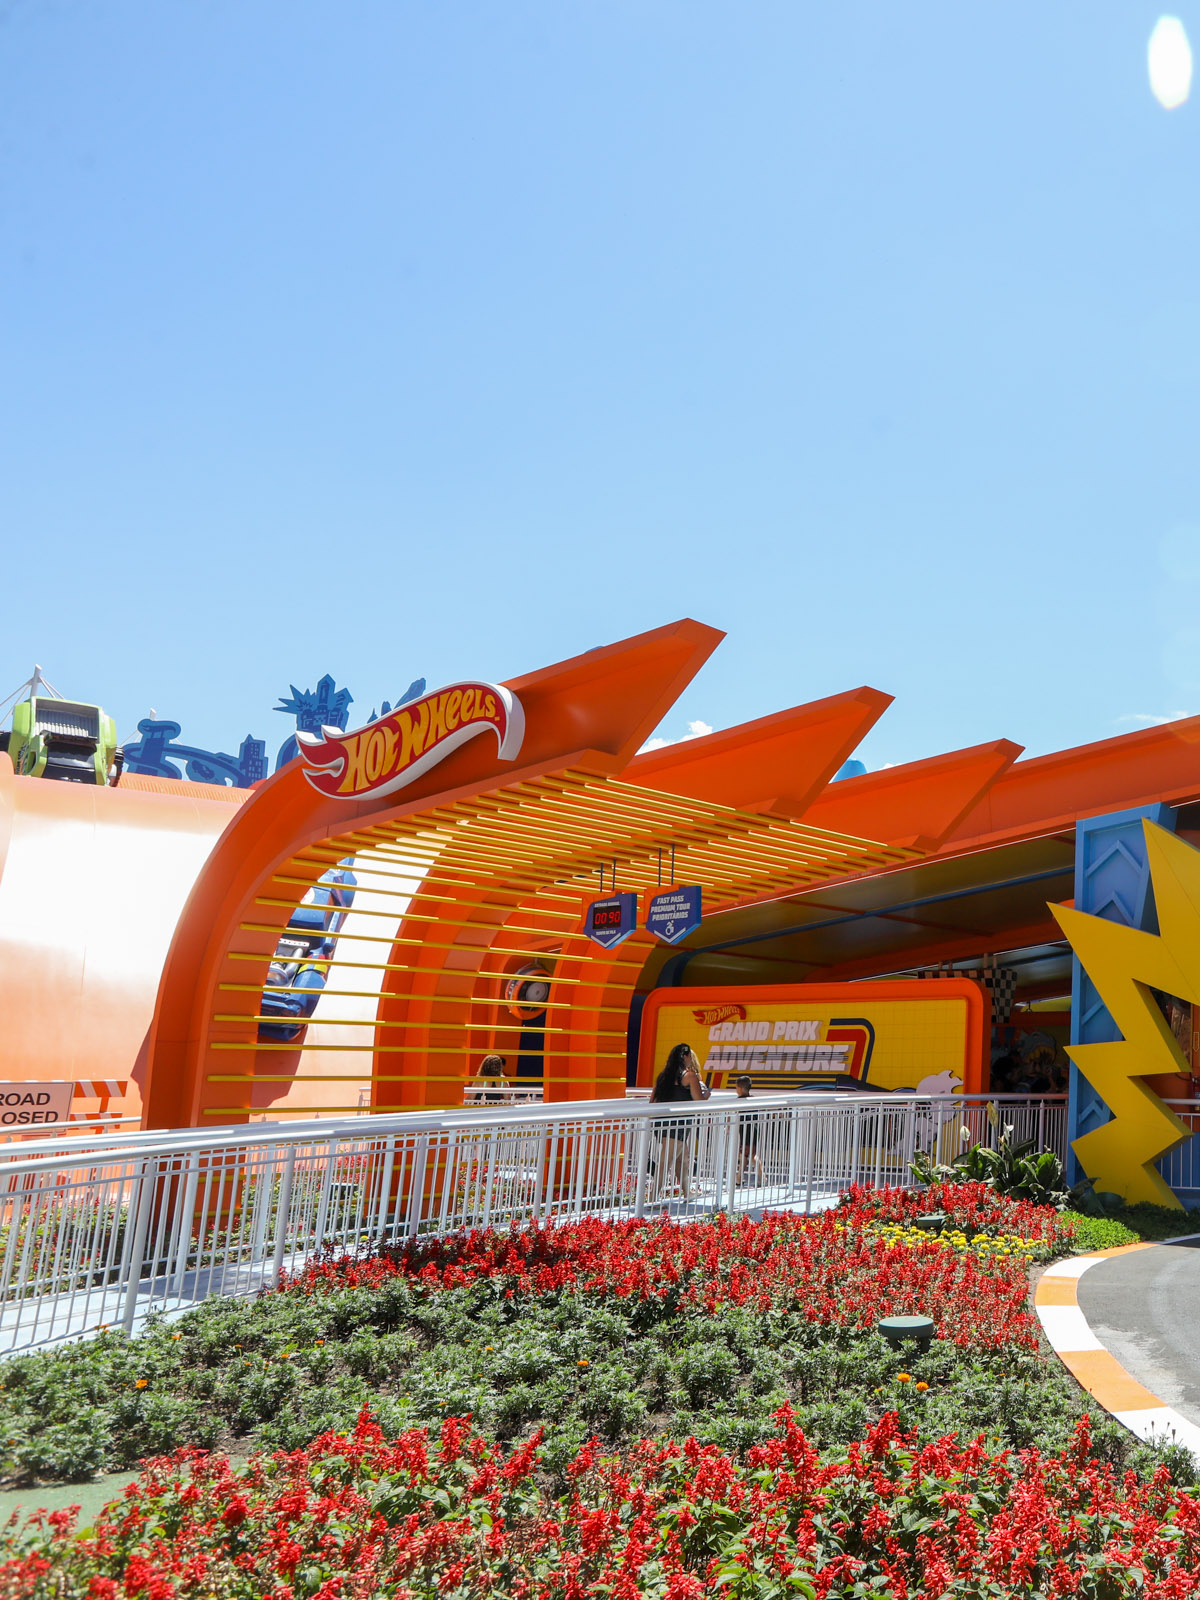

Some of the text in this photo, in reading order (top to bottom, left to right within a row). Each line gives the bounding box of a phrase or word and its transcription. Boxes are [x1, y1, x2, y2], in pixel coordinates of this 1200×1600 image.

[657, 895, 684, 904] FAST PASS
[676, 903, 691, 911] TOUR
[708, 1020, 820, 1041] GRAND PRIX
[703, 1044, 851, 1071] ADVENTURE
[0, 1111, 59, 1124] OSED
